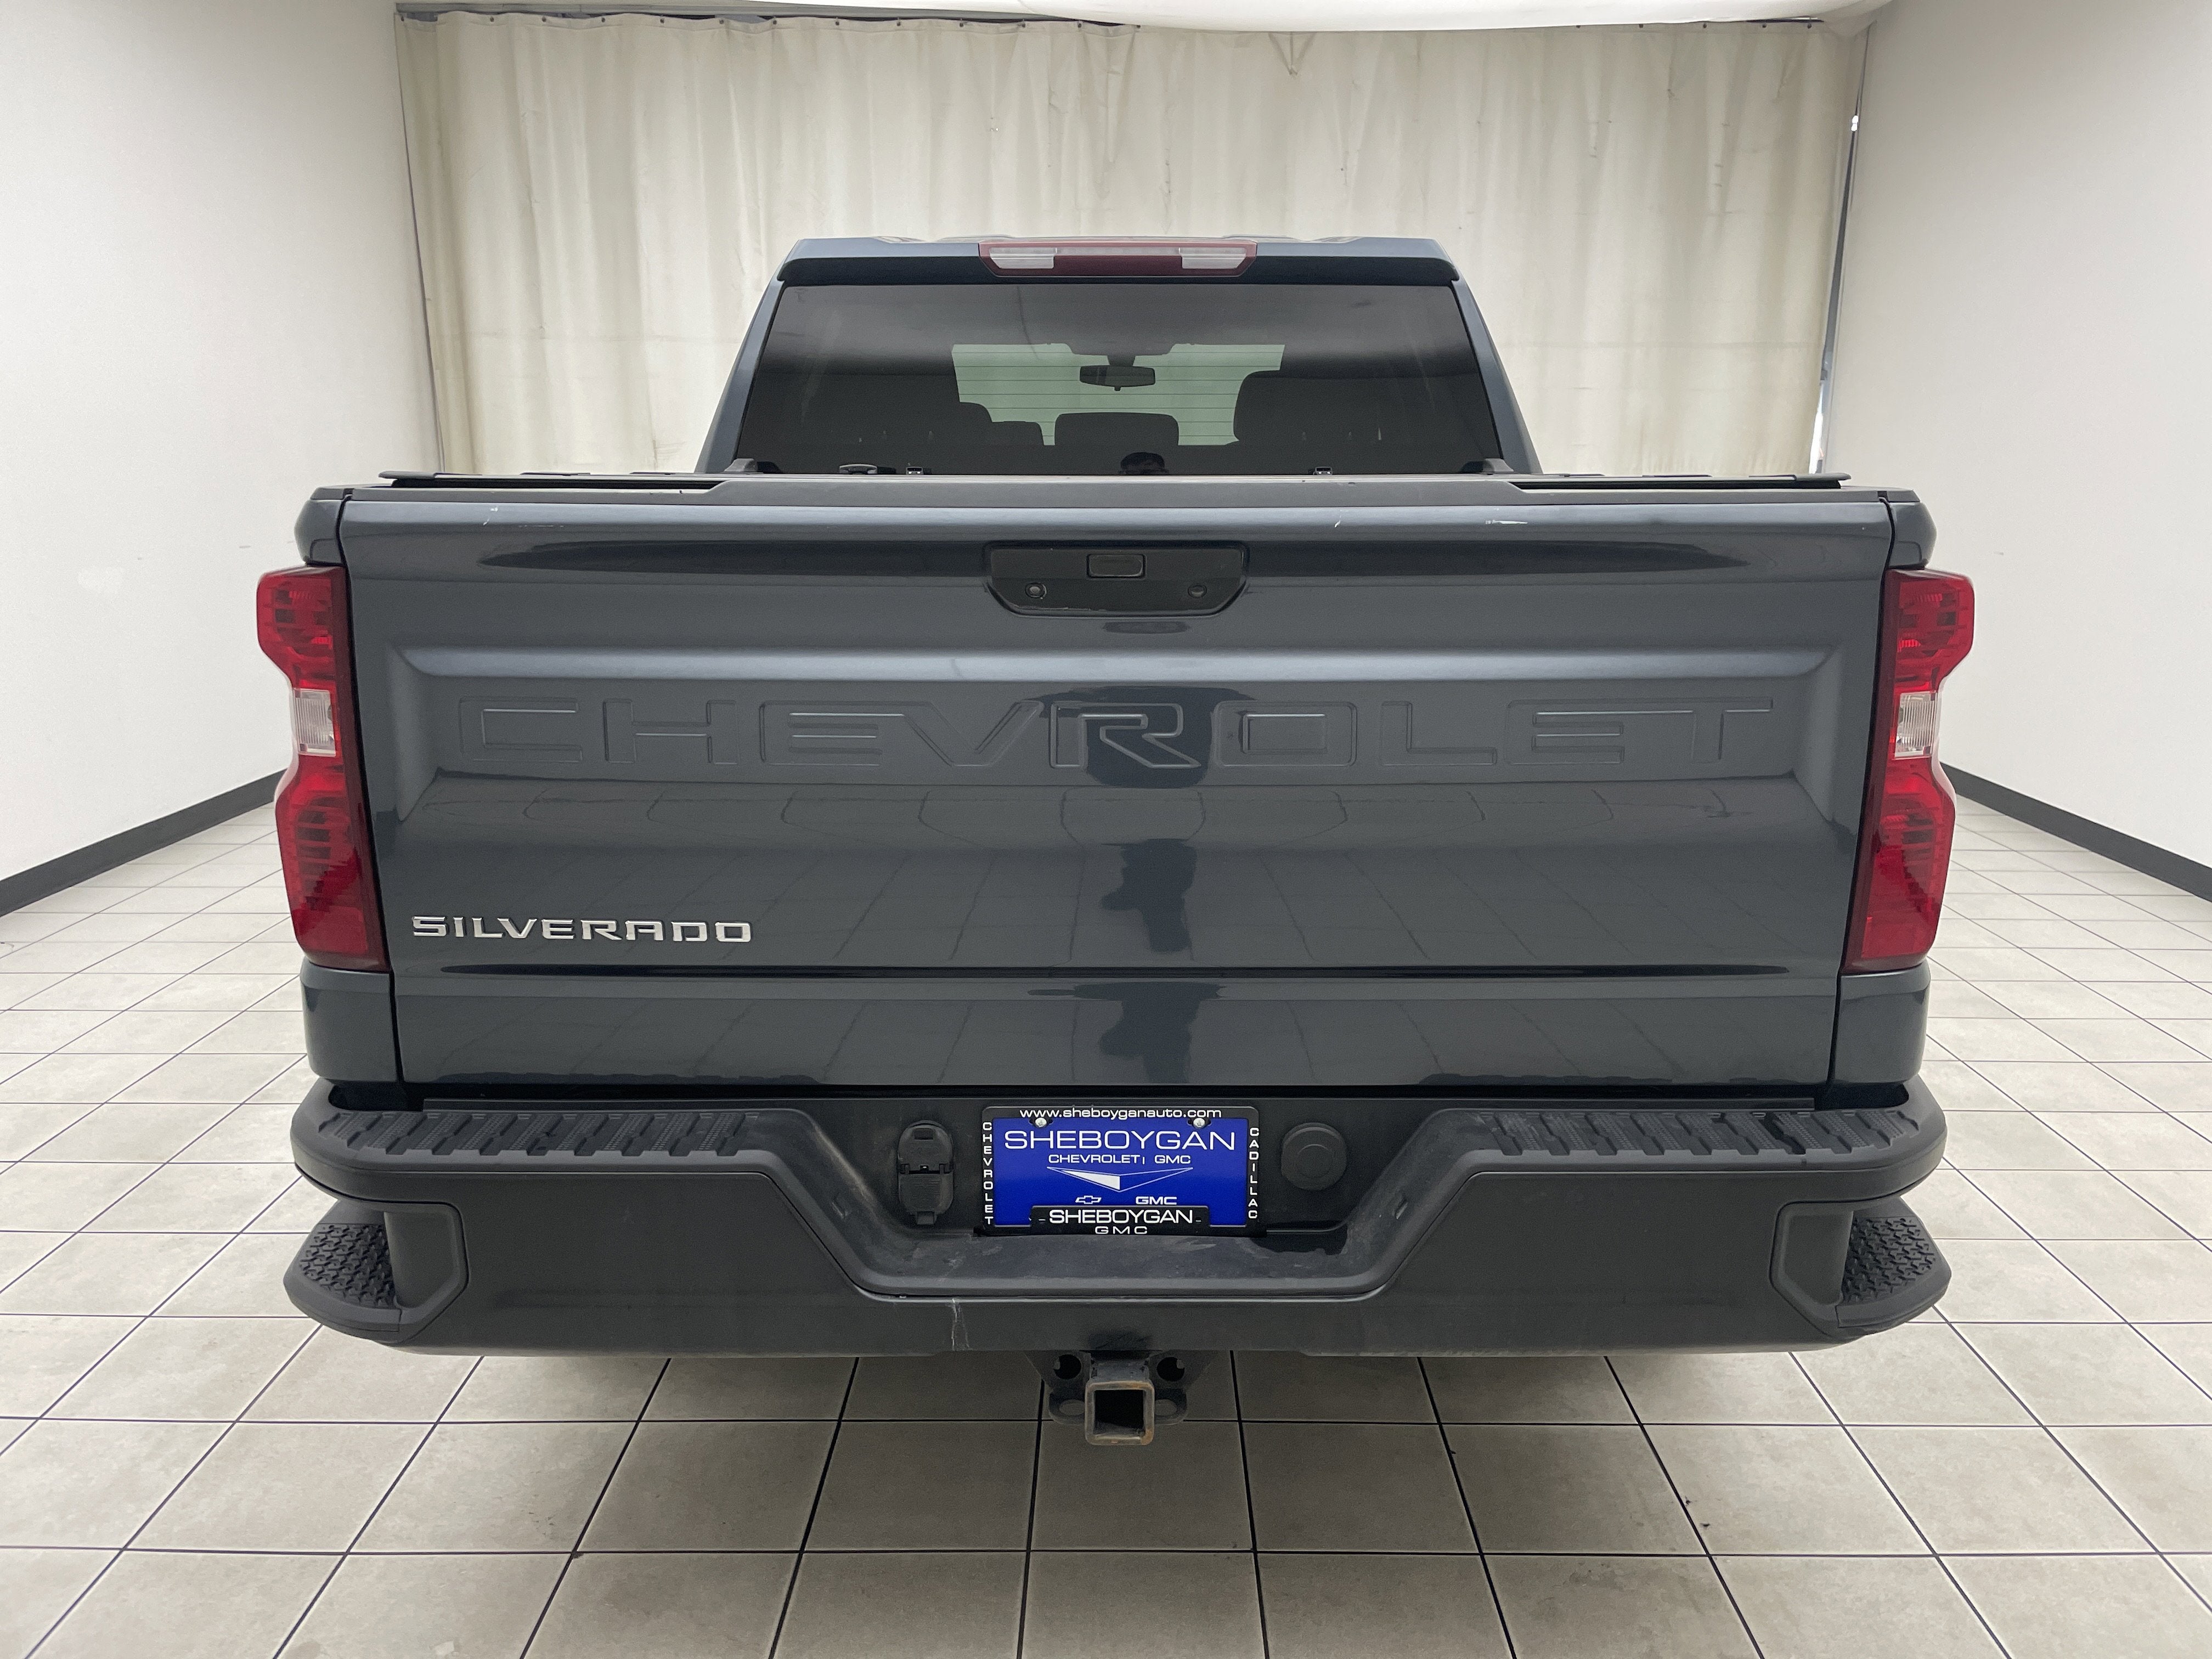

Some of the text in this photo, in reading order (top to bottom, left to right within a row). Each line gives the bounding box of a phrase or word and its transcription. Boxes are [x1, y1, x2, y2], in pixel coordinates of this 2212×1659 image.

[460, 696, 1773, 767] CHEVROLET
[411, 916, 751, 943] SILVERADO
[1019, 1108, 1222, 1120] www.sheboyganauto.com
[1005, 1130, 1235, 1150] SHEBOYGAN
[1048, 1154, 1191, 1165] CHEVROLET GMC
[982, 1121, 994, 1225] CHEVROLET
[1248, 1127, 1260, 1219] CADILLAC
[1135, 1196, 1177, 1205] GMC
[1049, 1209, 1193, 1224] SHEBOYGAN
[1094, 1226, 1148, 1234] GMC
